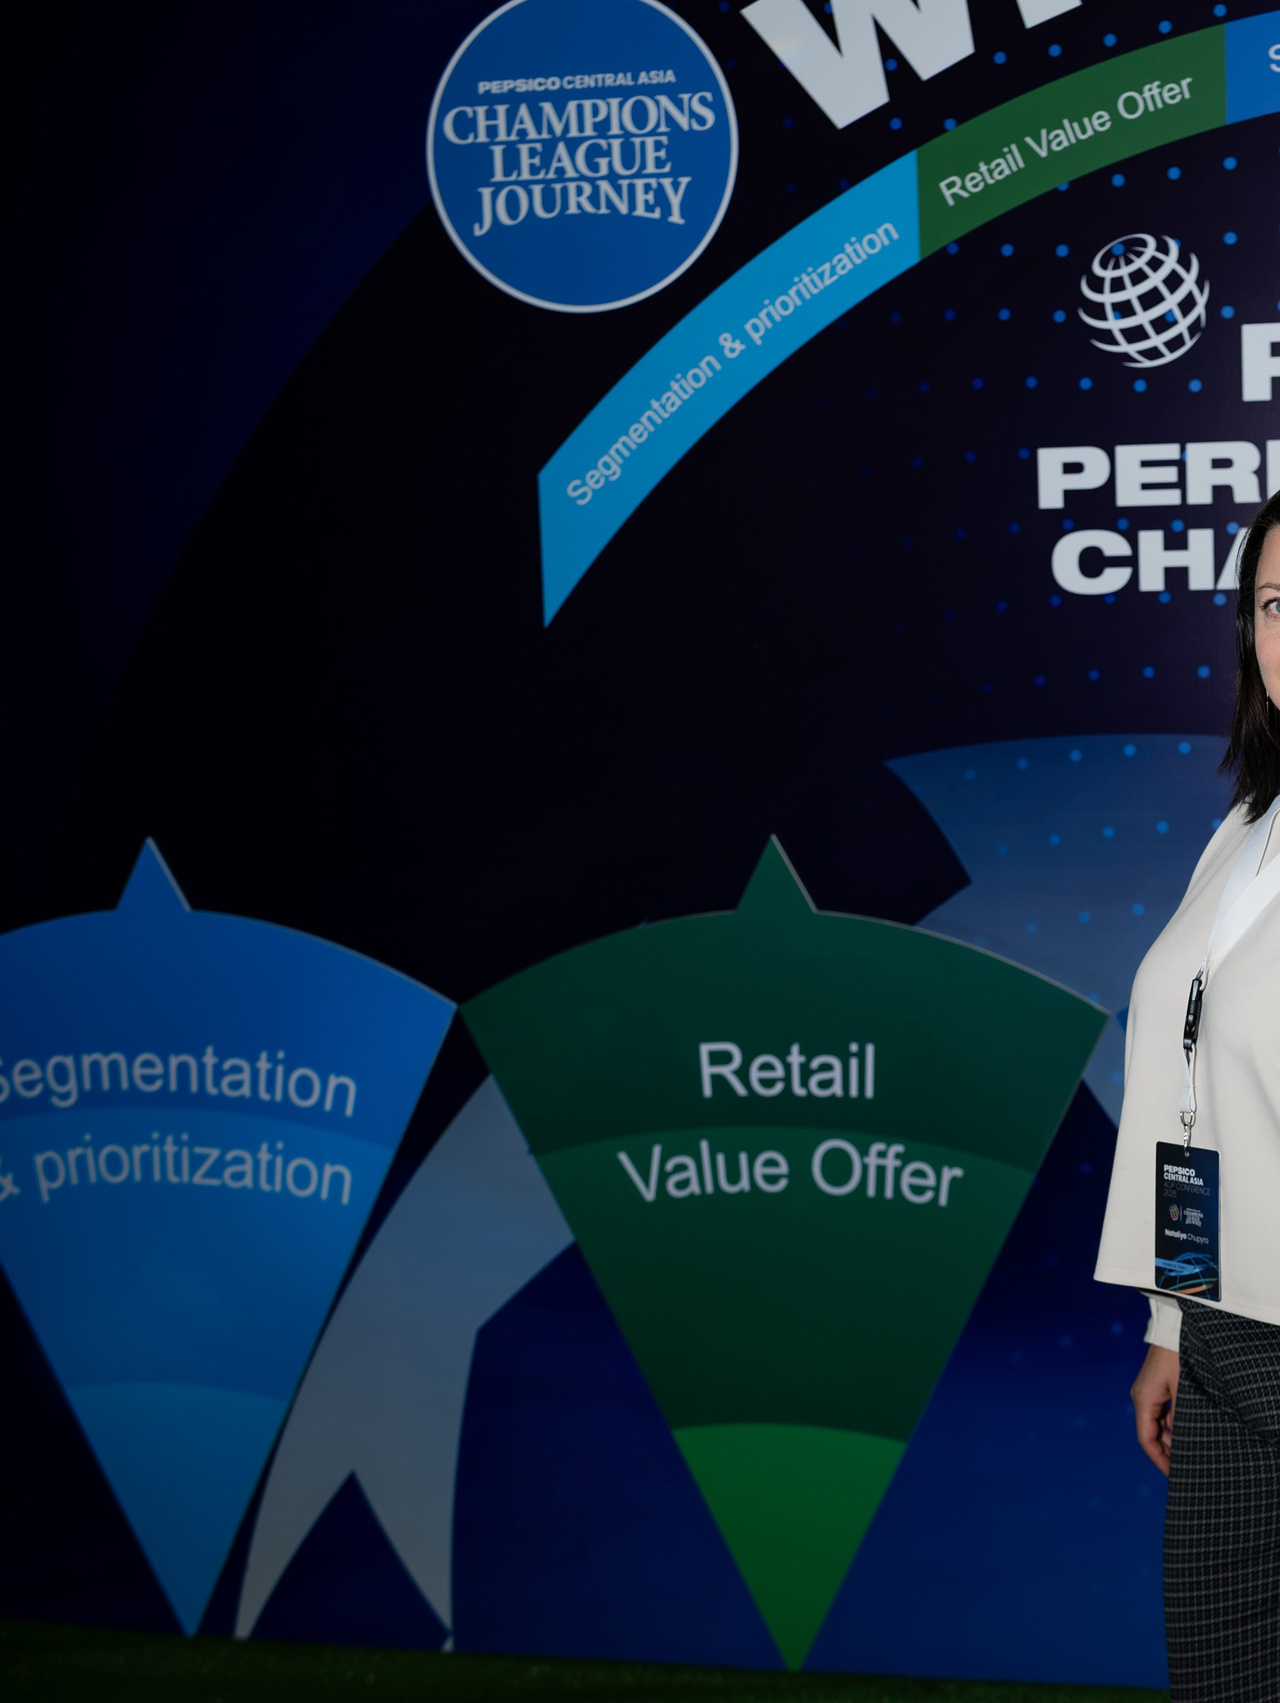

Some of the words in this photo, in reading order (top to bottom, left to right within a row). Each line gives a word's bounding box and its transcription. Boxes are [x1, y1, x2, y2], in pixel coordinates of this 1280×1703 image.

[477, 76, 561, 95] PEPSICO
[562, 72, 636, 89] CENTRAL
[636, 69, 678, 85] ASIA
[442, 91, 716, 145] CHAMPIONS
[938, 148, 1025, 207] Retail
[1024, 109, 1112, 159] Value
[1117, 77, 1194, 120] Offer
[489, 135, 672, 183] LEAGUE
[472, 176, 692, 237] JOURNEY
[565, 354, 722, 506] Segmentation
[718, 332, 747, 359] &
[743, 222, 900, 346] prioritization
[0, 1045, 357, 1118] egmentation
[698, 1041, 875, 1099] Retail
[34, 1132, 352, 1206] prioritization
[616, 1139, 790, 1203] Value
[811, 1138, 964, 1207] Offer
[1163, 1164, 1196, 1177] PEPSICO
[1163, 1172, 1190, 1183] CENTRAL
[1190, 1177, 1204, 1186] ASIA
